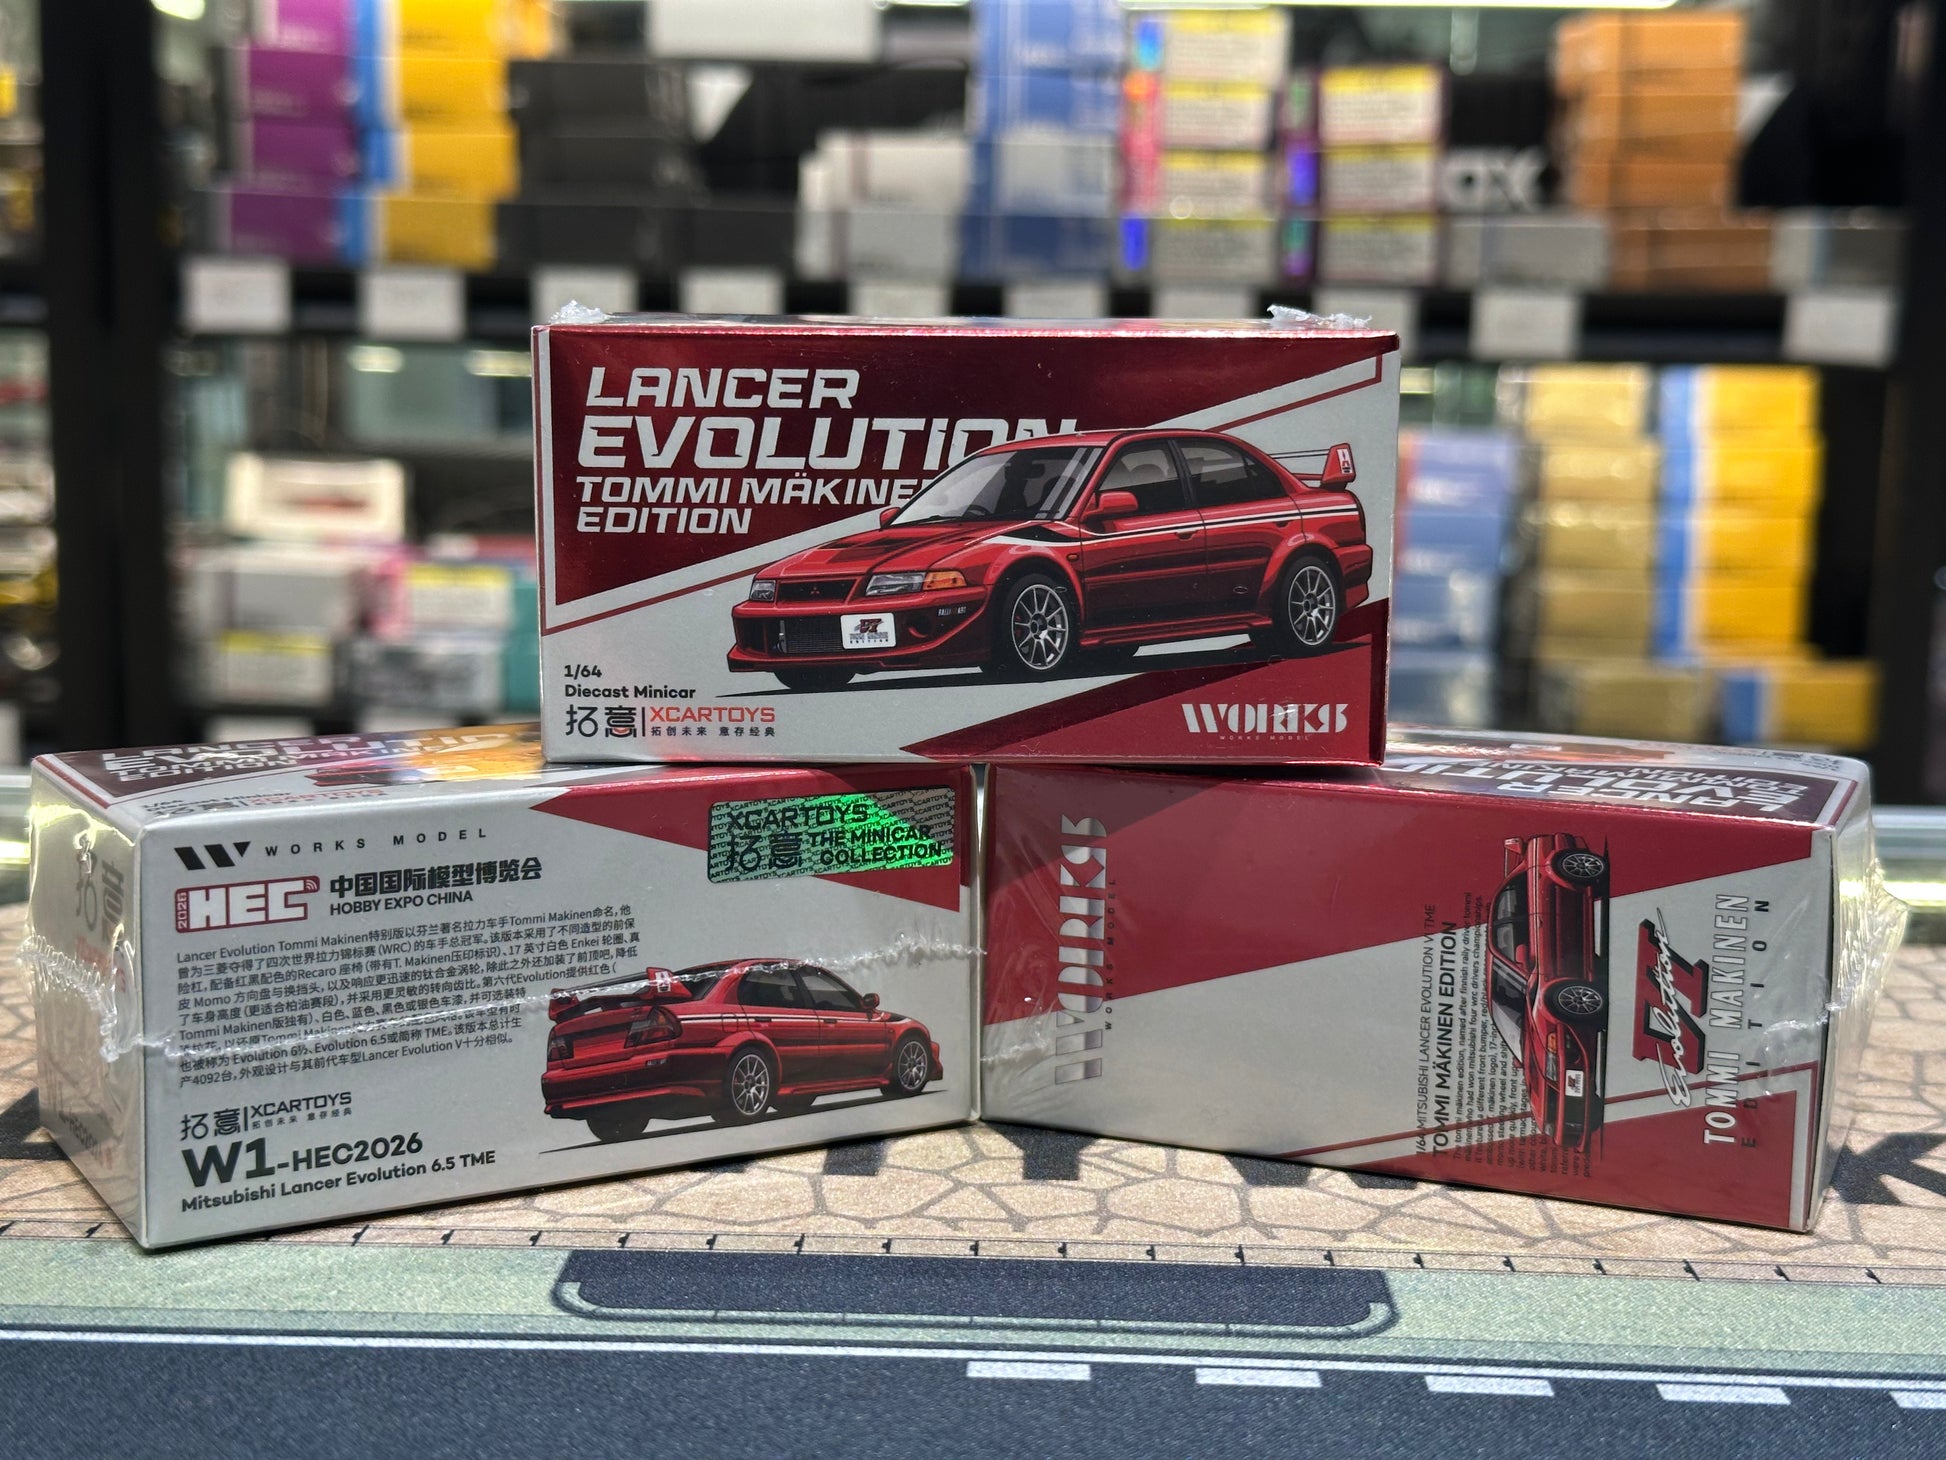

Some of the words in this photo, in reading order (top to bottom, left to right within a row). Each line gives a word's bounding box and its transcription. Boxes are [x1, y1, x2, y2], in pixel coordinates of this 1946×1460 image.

[586, 367, 860, 409] LANCER
[576, 476, 731, 504] TOMMI
[577, 506, 752, 534] EDITION
[564, 664, 602, 680] 1/64
[565, 684, 629, 698] Diecast
[634, 685, 696, 698] Minicar
[566, 704, 636, 738] 拓意
[650, 706, 776, 722] XCARTOYS
[1181, 703, 1349, 733] WORKS
[651, 726, 707, 736] 拓创未来
[719, 726, 776, 737] 意存经典
[101, 735, 361, 760] LANCER
[117, 758, 299, 781] EDITION
[1497, 780, 1781, 812] LANCER
[726, 804, 868, 831] XCARTOYS
[265, 839, 366, 857] WORKS
[393, 828, 487, 846] MODEL
[809, 831, 846, 848] THE
[851, 824, 932, 846] MINICAR
[820, 842, 943, 866] COLLECTION
[330, 857, 543, 899] 中国国际模型博览会
[176, 891, 188, 930] 2026
[189, 879, 305, 931] HEC
[329, 898, 381, 916] HOBBY
[384, 894, 424, 911] EXPO
[426, 890, 474, 907] CHINA
[1106, 879, 1117, 946] MODEL
[571, 936, 599, 949] Enkei
[1461, 920, 1470, 944] driver
[177, 948, 217, 963] Lancer
[220, 942, 275, 958] Evolution
[277, 937, 317, 951] Tommi
[1055, 813, 1107, 1085] WORKS
[1438, 921, 1456, 997] EDITION
[1459, 947, 1470, 964] rally
[1708, 893, 1749, 1029] MAKINEN
[1420, 946, 1434, 1012] EVOLUTION
[1458, 966, 1468, 993] finnish
[1469, 960, 1479, 988] drivers
[194, 994, 230, 1008] Momo
[1104, 962, 1114, 1031] WORKS
[1458, 996, 1466, 1015] after
[1470, 991, 1478, 1006] wrc
[1651, 906, 1691, 1108] Evolution
[1468, 1008, 1477, 1025] four
[179, 1025, 219, 1042] Tommi
[1419, 1016, 1430, 1061] LANCER
[1432, 1002, 1453, 1089] MÄKINEN
[1456, 1018, 1466, 1045] named
[1477, 1019, 1488, 1052] bumper,
[233, 1046, 287, 1065] Evolution
[402, 1039, 452, 1057] Evolution
[1466, 1027, 1476, 1068] mitsubishi
[1477, 1053, 1485, 1074] front
[1498, 1060, 1506, 1076] and
[1416, 1065, 1428, 1129] MITSUBISHI
[1465, 1090, 1473, 1105] had
[1476, 1076, 1485, 1111] different
[1498, 1077, 1506, 1102] wheel
[1703, 1050, 1740, 1147] TOMMI
[250, 1091, 352, 1118] XCARTOYS
[180, 1107, 241, 1141] 拓意
[1432, 1094, 1450, 1158] TOMMI
[182, 1132, 424, 1188] W1-HEC2026
[182, 1184, 276, 1212] Mitsubishi
[281, 1176, 341, 1197] Lancer
[346, 1162, 427, 1186] Evolution
[431, 1157, 456, 1173] 6.5
[459, 1150, 496, 1168] TME
